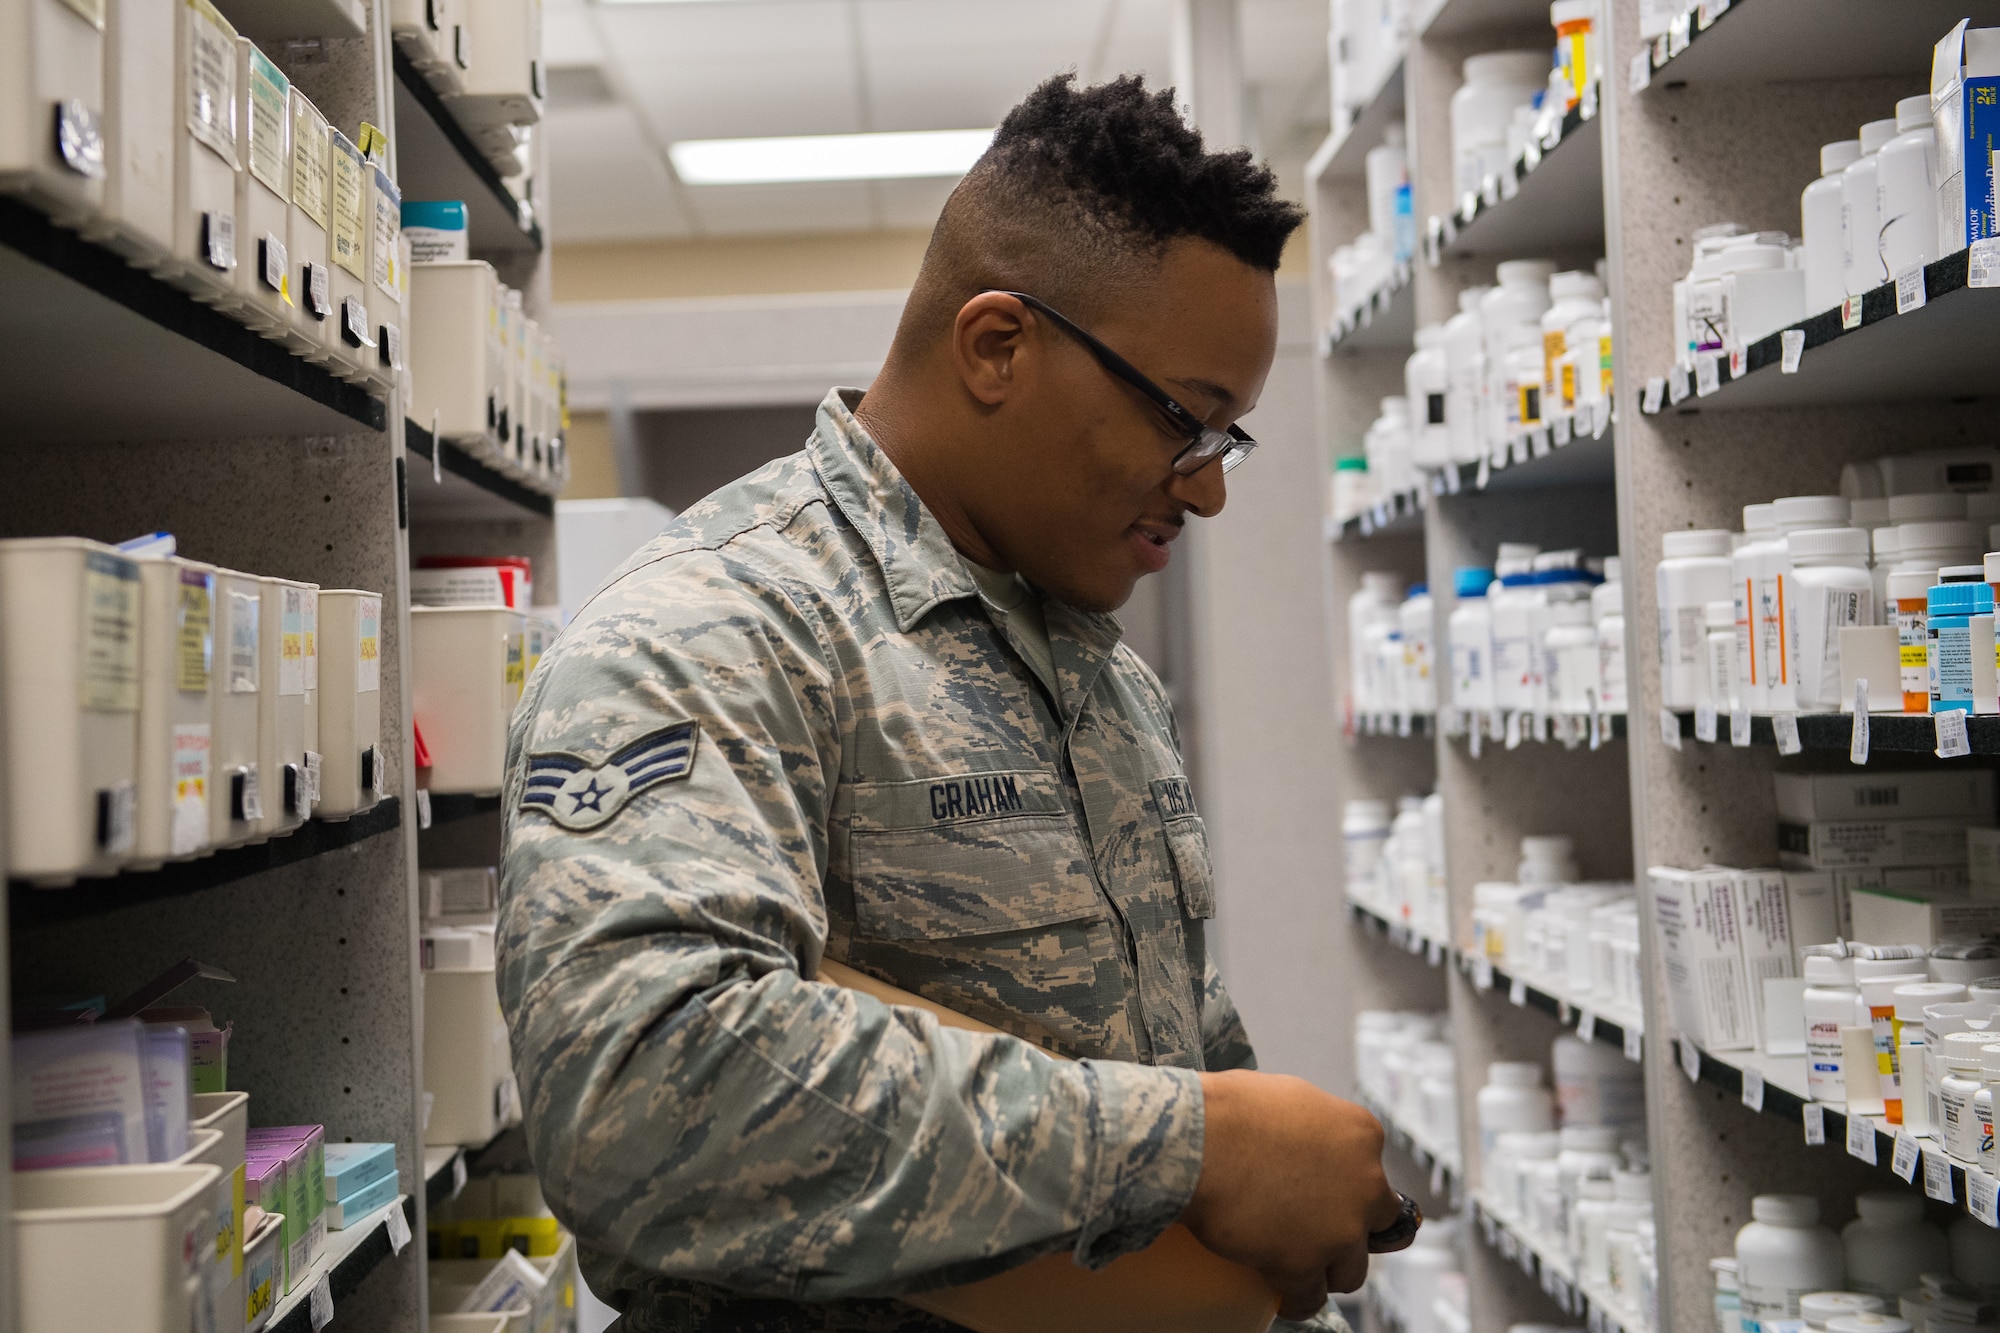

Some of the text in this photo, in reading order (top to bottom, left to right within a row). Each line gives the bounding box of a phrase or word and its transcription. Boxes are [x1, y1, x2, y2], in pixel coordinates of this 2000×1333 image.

[1976, 87, 1990, 105] 24
[1970, 208, 1980, 242] MAJOR
[930, 776, 1022, 819] GRAHAM
